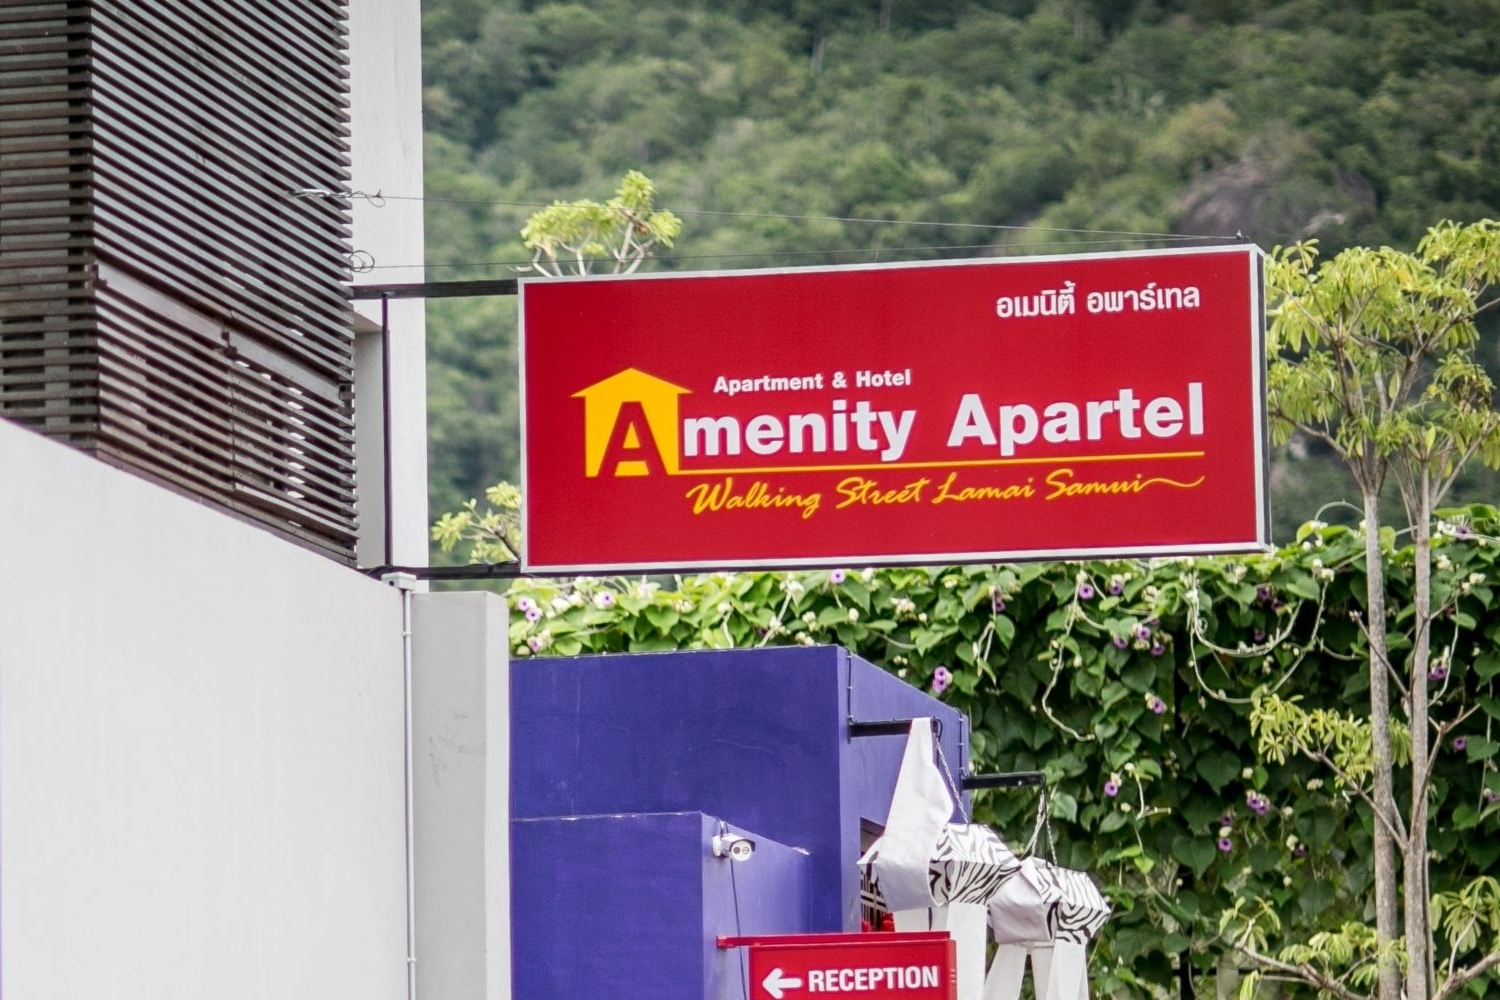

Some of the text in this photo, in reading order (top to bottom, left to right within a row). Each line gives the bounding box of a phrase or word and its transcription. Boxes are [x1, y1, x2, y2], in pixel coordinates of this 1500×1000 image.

[1087, 282, 1200, 313] อพาร์เทล
[713, 368, 912, 395] Apartment & Hotel
[597, 382, 1204, 478] Amenity Apartel
[685, 468, 1205, 519] Walking Street Lamai Samui
[808, 965, 939, 992] RECEPTION
